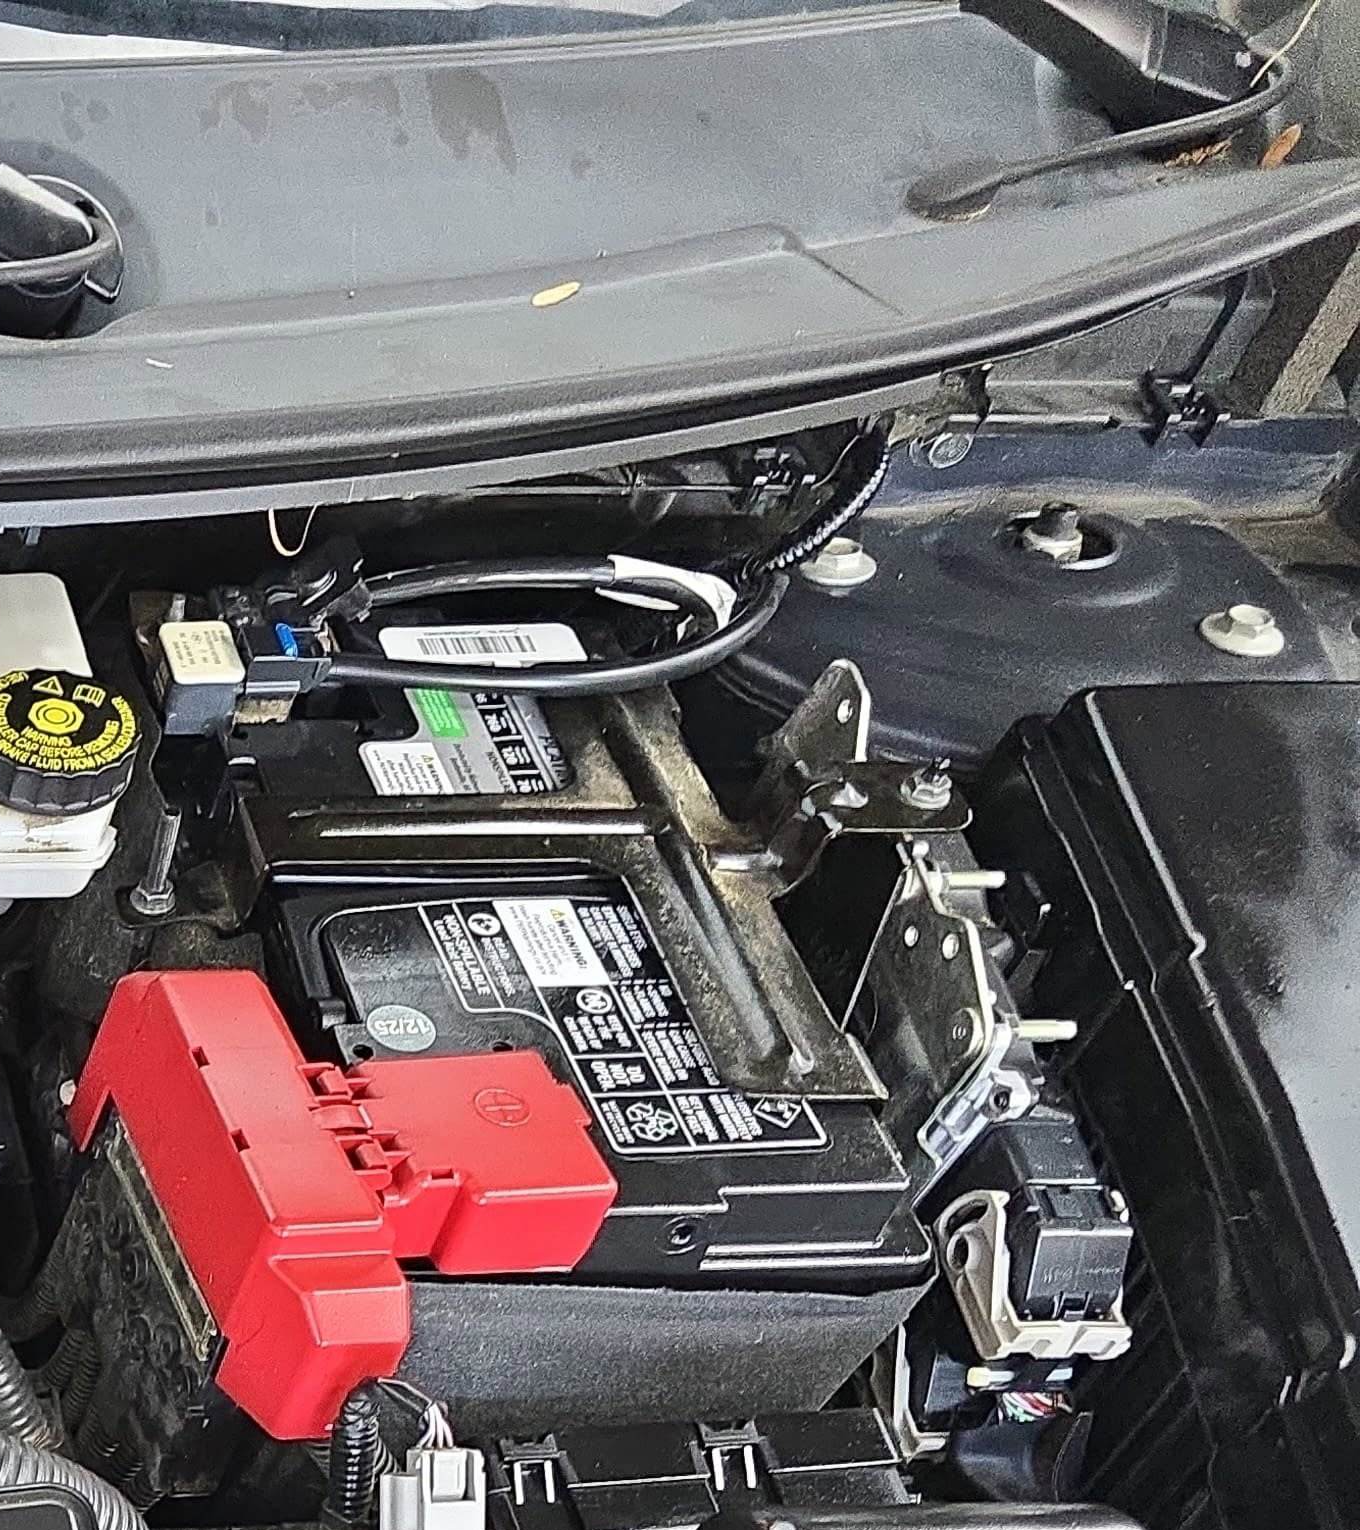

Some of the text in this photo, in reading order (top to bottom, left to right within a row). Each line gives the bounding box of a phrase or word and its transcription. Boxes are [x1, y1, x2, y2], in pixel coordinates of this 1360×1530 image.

[20, 725, 72, 747] WARNING
[16, 738, 39, 751] CAP
[40, 746, 85, 758] BEFORE
[29, 755, 62, 770] FLUID
[64, 757, 98, 770] FROM
[444, 916, 490, 994] NON-SPILLABLE
[493, 938, 510, 959] READ
[374, 1018, 432, 1036] 12/25
[609, 1064, 630, 1085] NOT
[627, 1066, 645, 1082] DO
